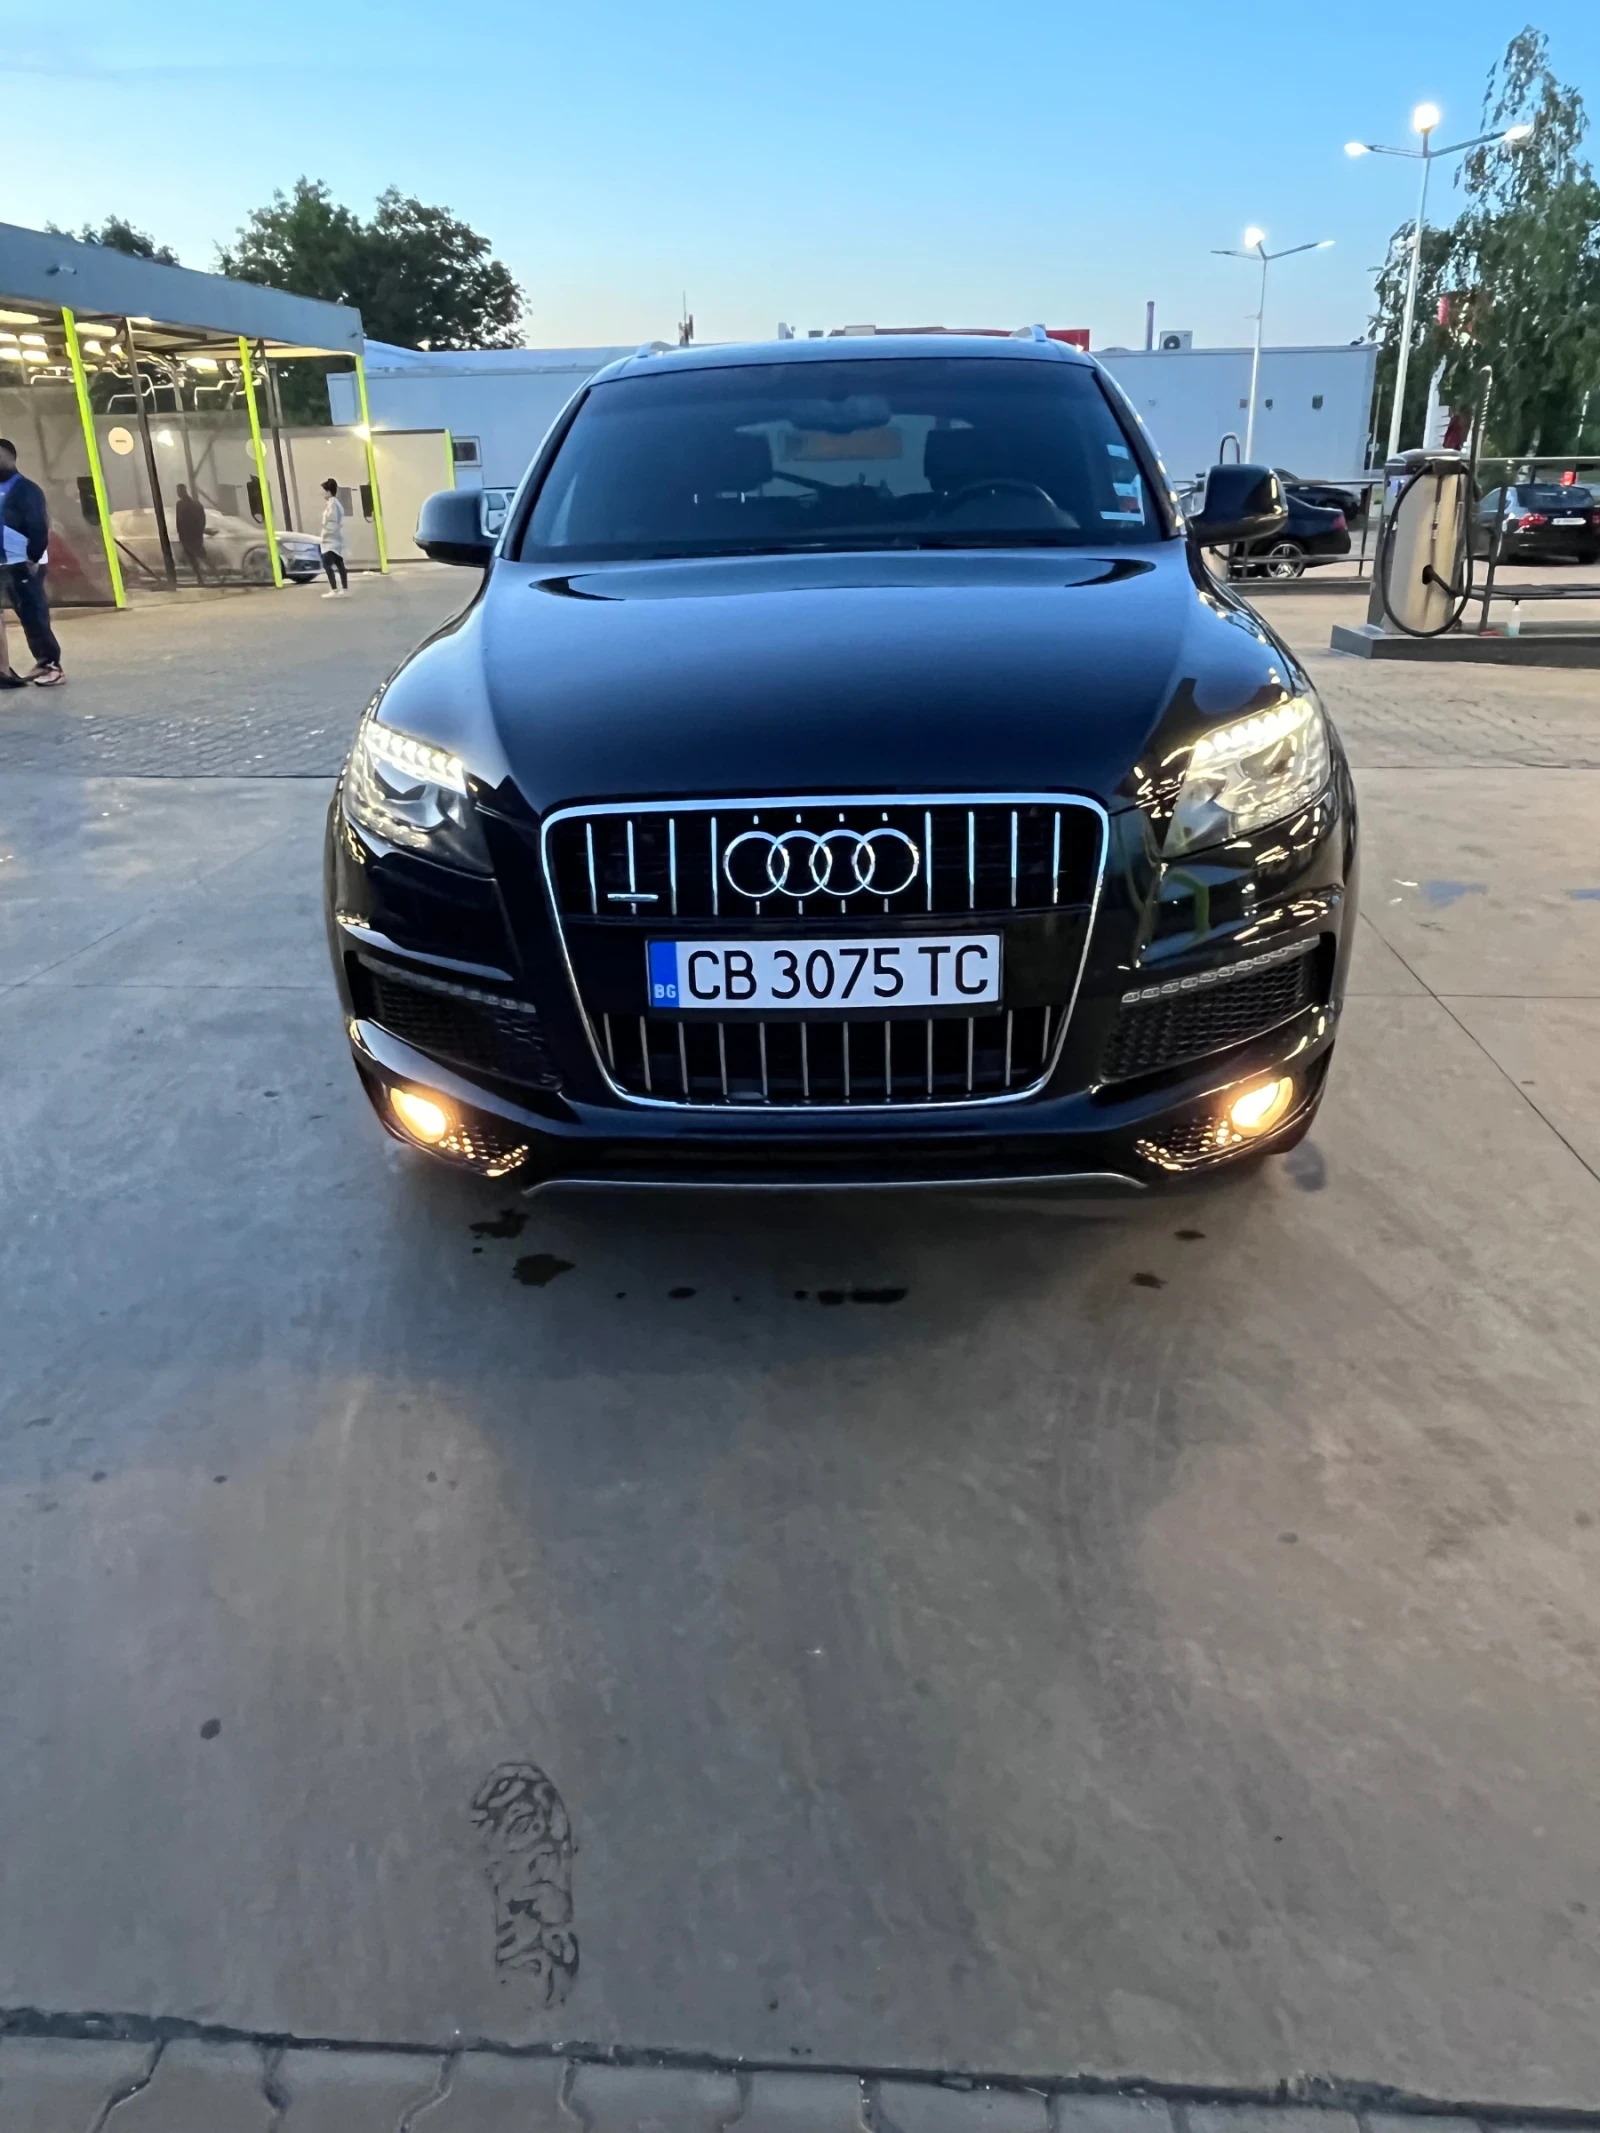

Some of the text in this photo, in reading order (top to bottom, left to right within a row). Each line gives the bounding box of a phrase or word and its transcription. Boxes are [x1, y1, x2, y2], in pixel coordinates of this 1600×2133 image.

[688, 944, 989, 1001] CB 3075 TC
[654, 984, 677, 999] BG
